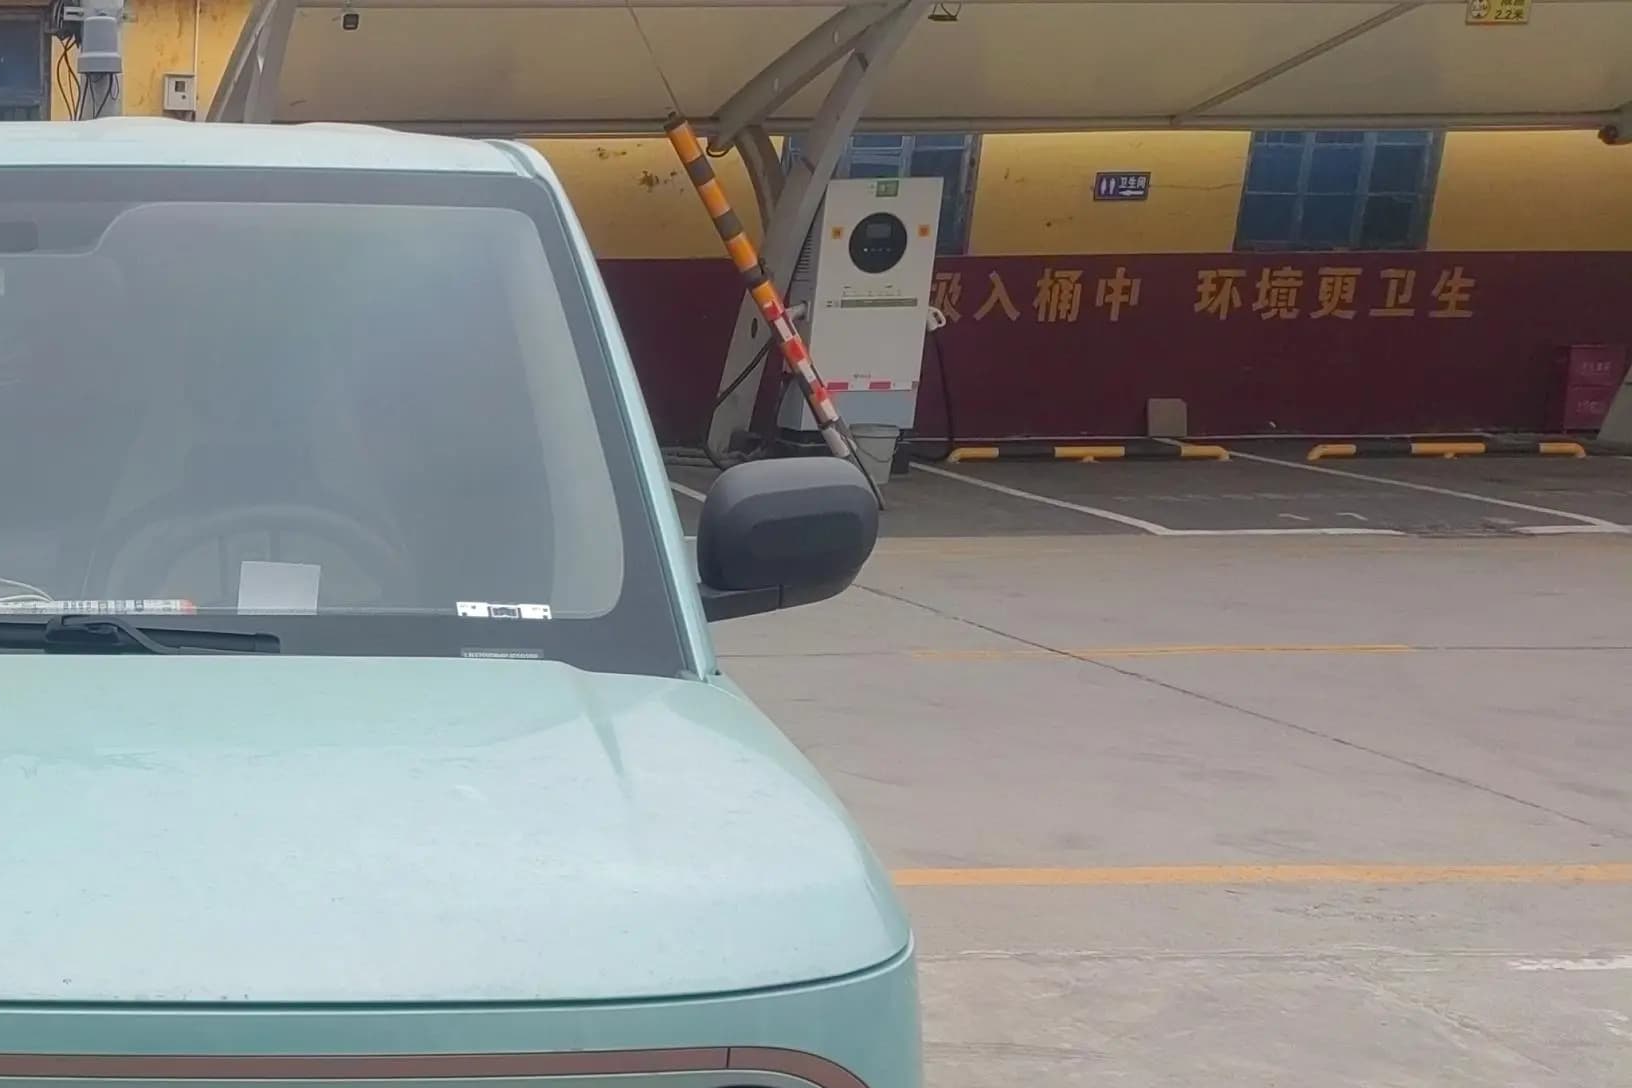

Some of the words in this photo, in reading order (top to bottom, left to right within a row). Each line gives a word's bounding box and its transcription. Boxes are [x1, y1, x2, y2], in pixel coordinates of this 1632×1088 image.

[1118, 175, 1147, 189] 卫生间
[1193, 265, 1476, 321] 环境更卫生
